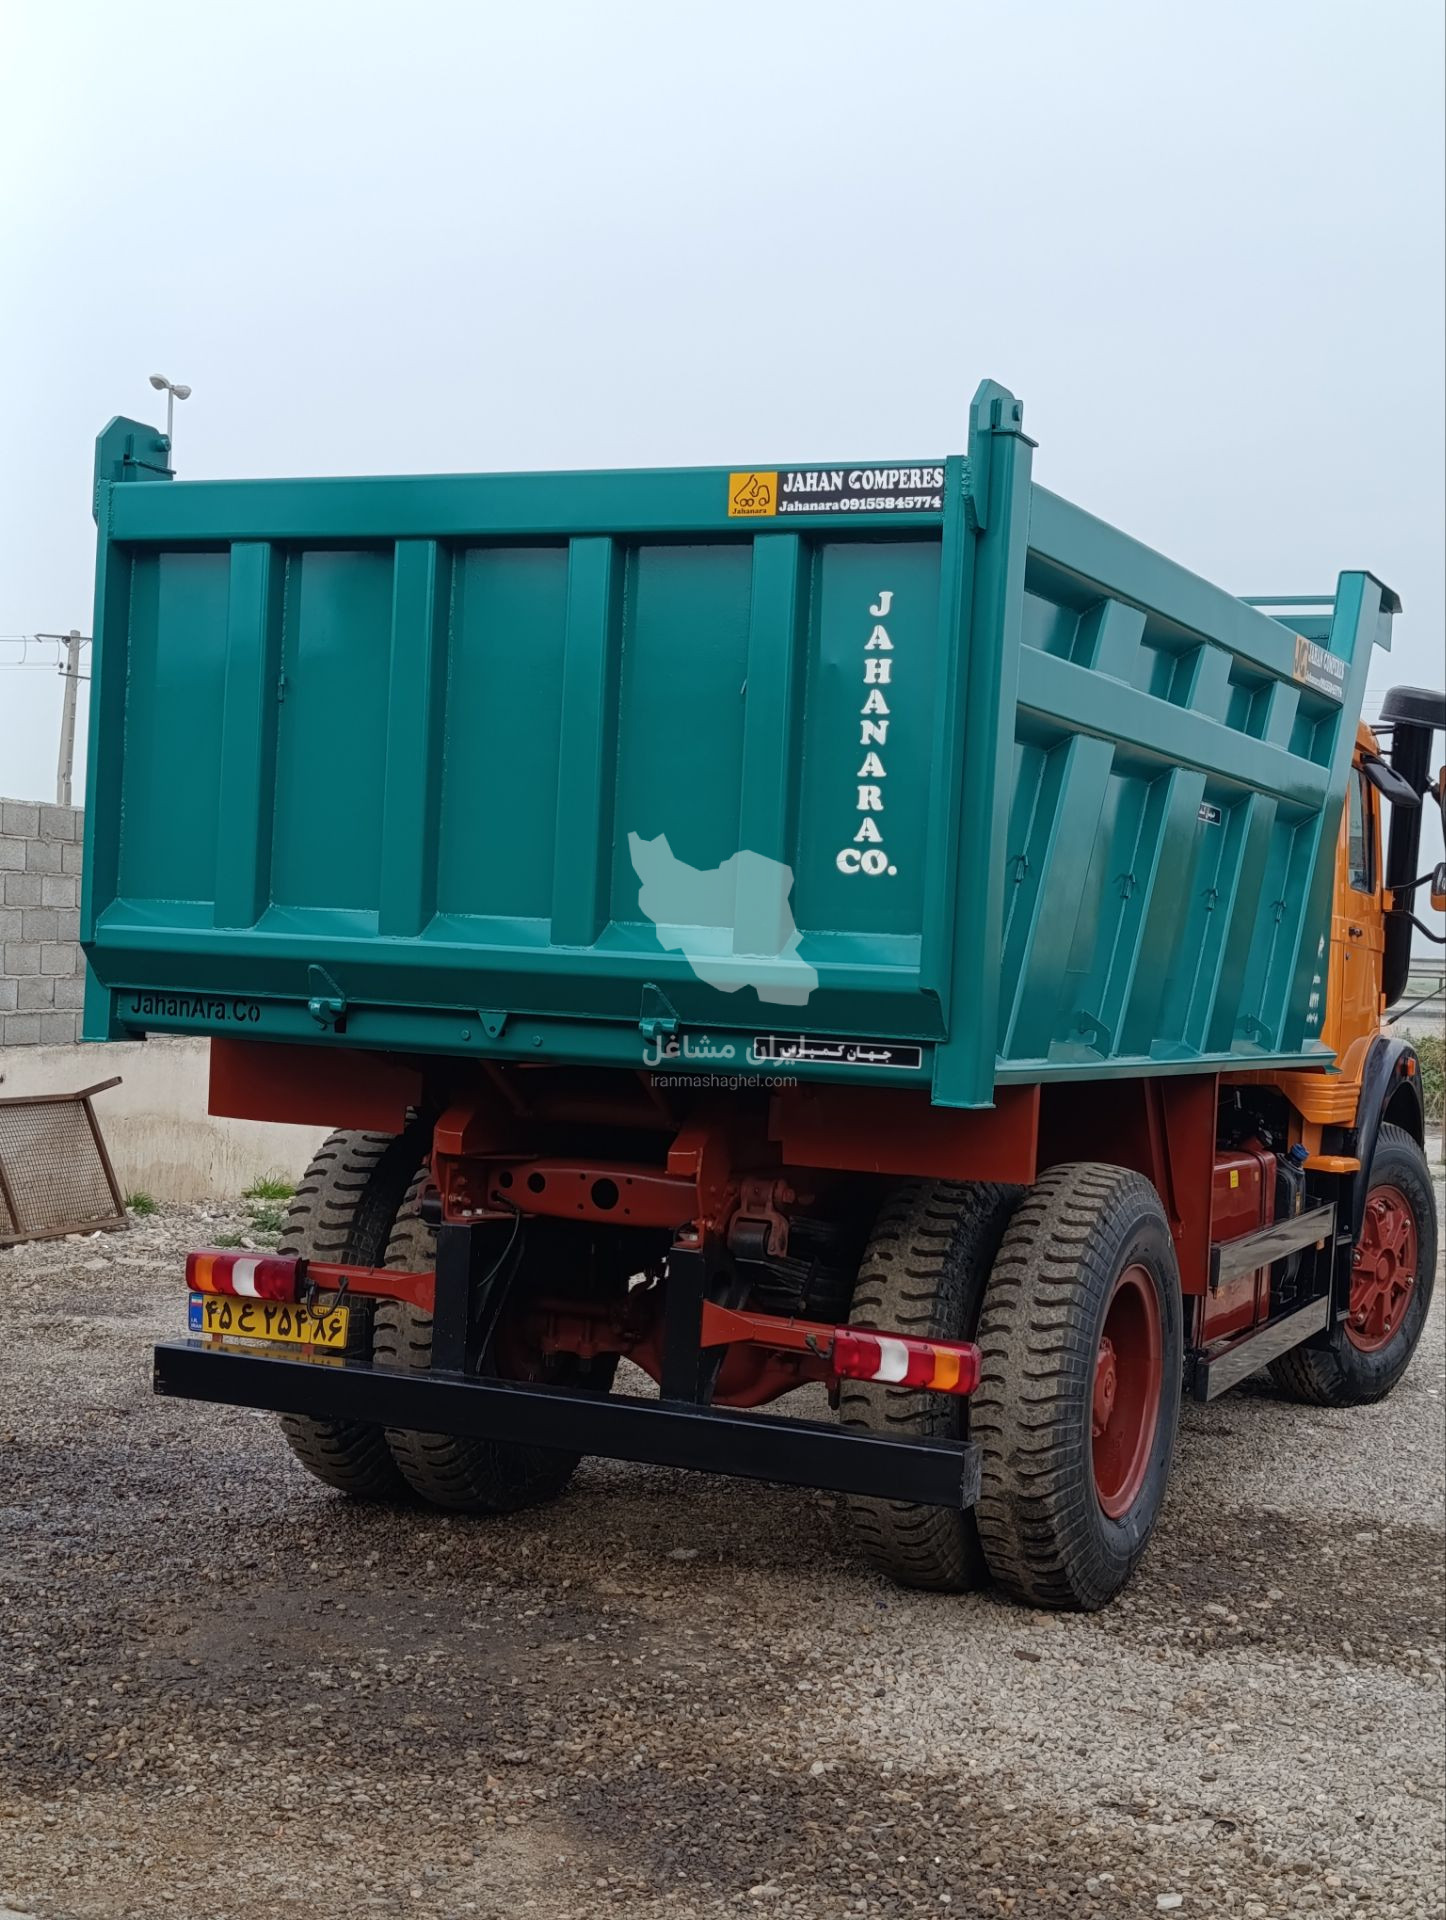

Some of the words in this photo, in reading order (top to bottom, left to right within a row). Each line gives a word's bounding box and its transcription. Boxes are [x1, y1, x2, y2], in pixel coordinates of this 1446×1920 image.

[783, 471, 844, 493] JAHAN
[848, 467, 944, 490] COMPERES
[779, 500, 839, 512] Jahanara
[839, 495, 942, 511] 09155845774
[853, 590, 895, 843] JAHANARA
[836, 847, 898, 876] CO.
[131, 992, 261, 1023] JahanAra.Co
